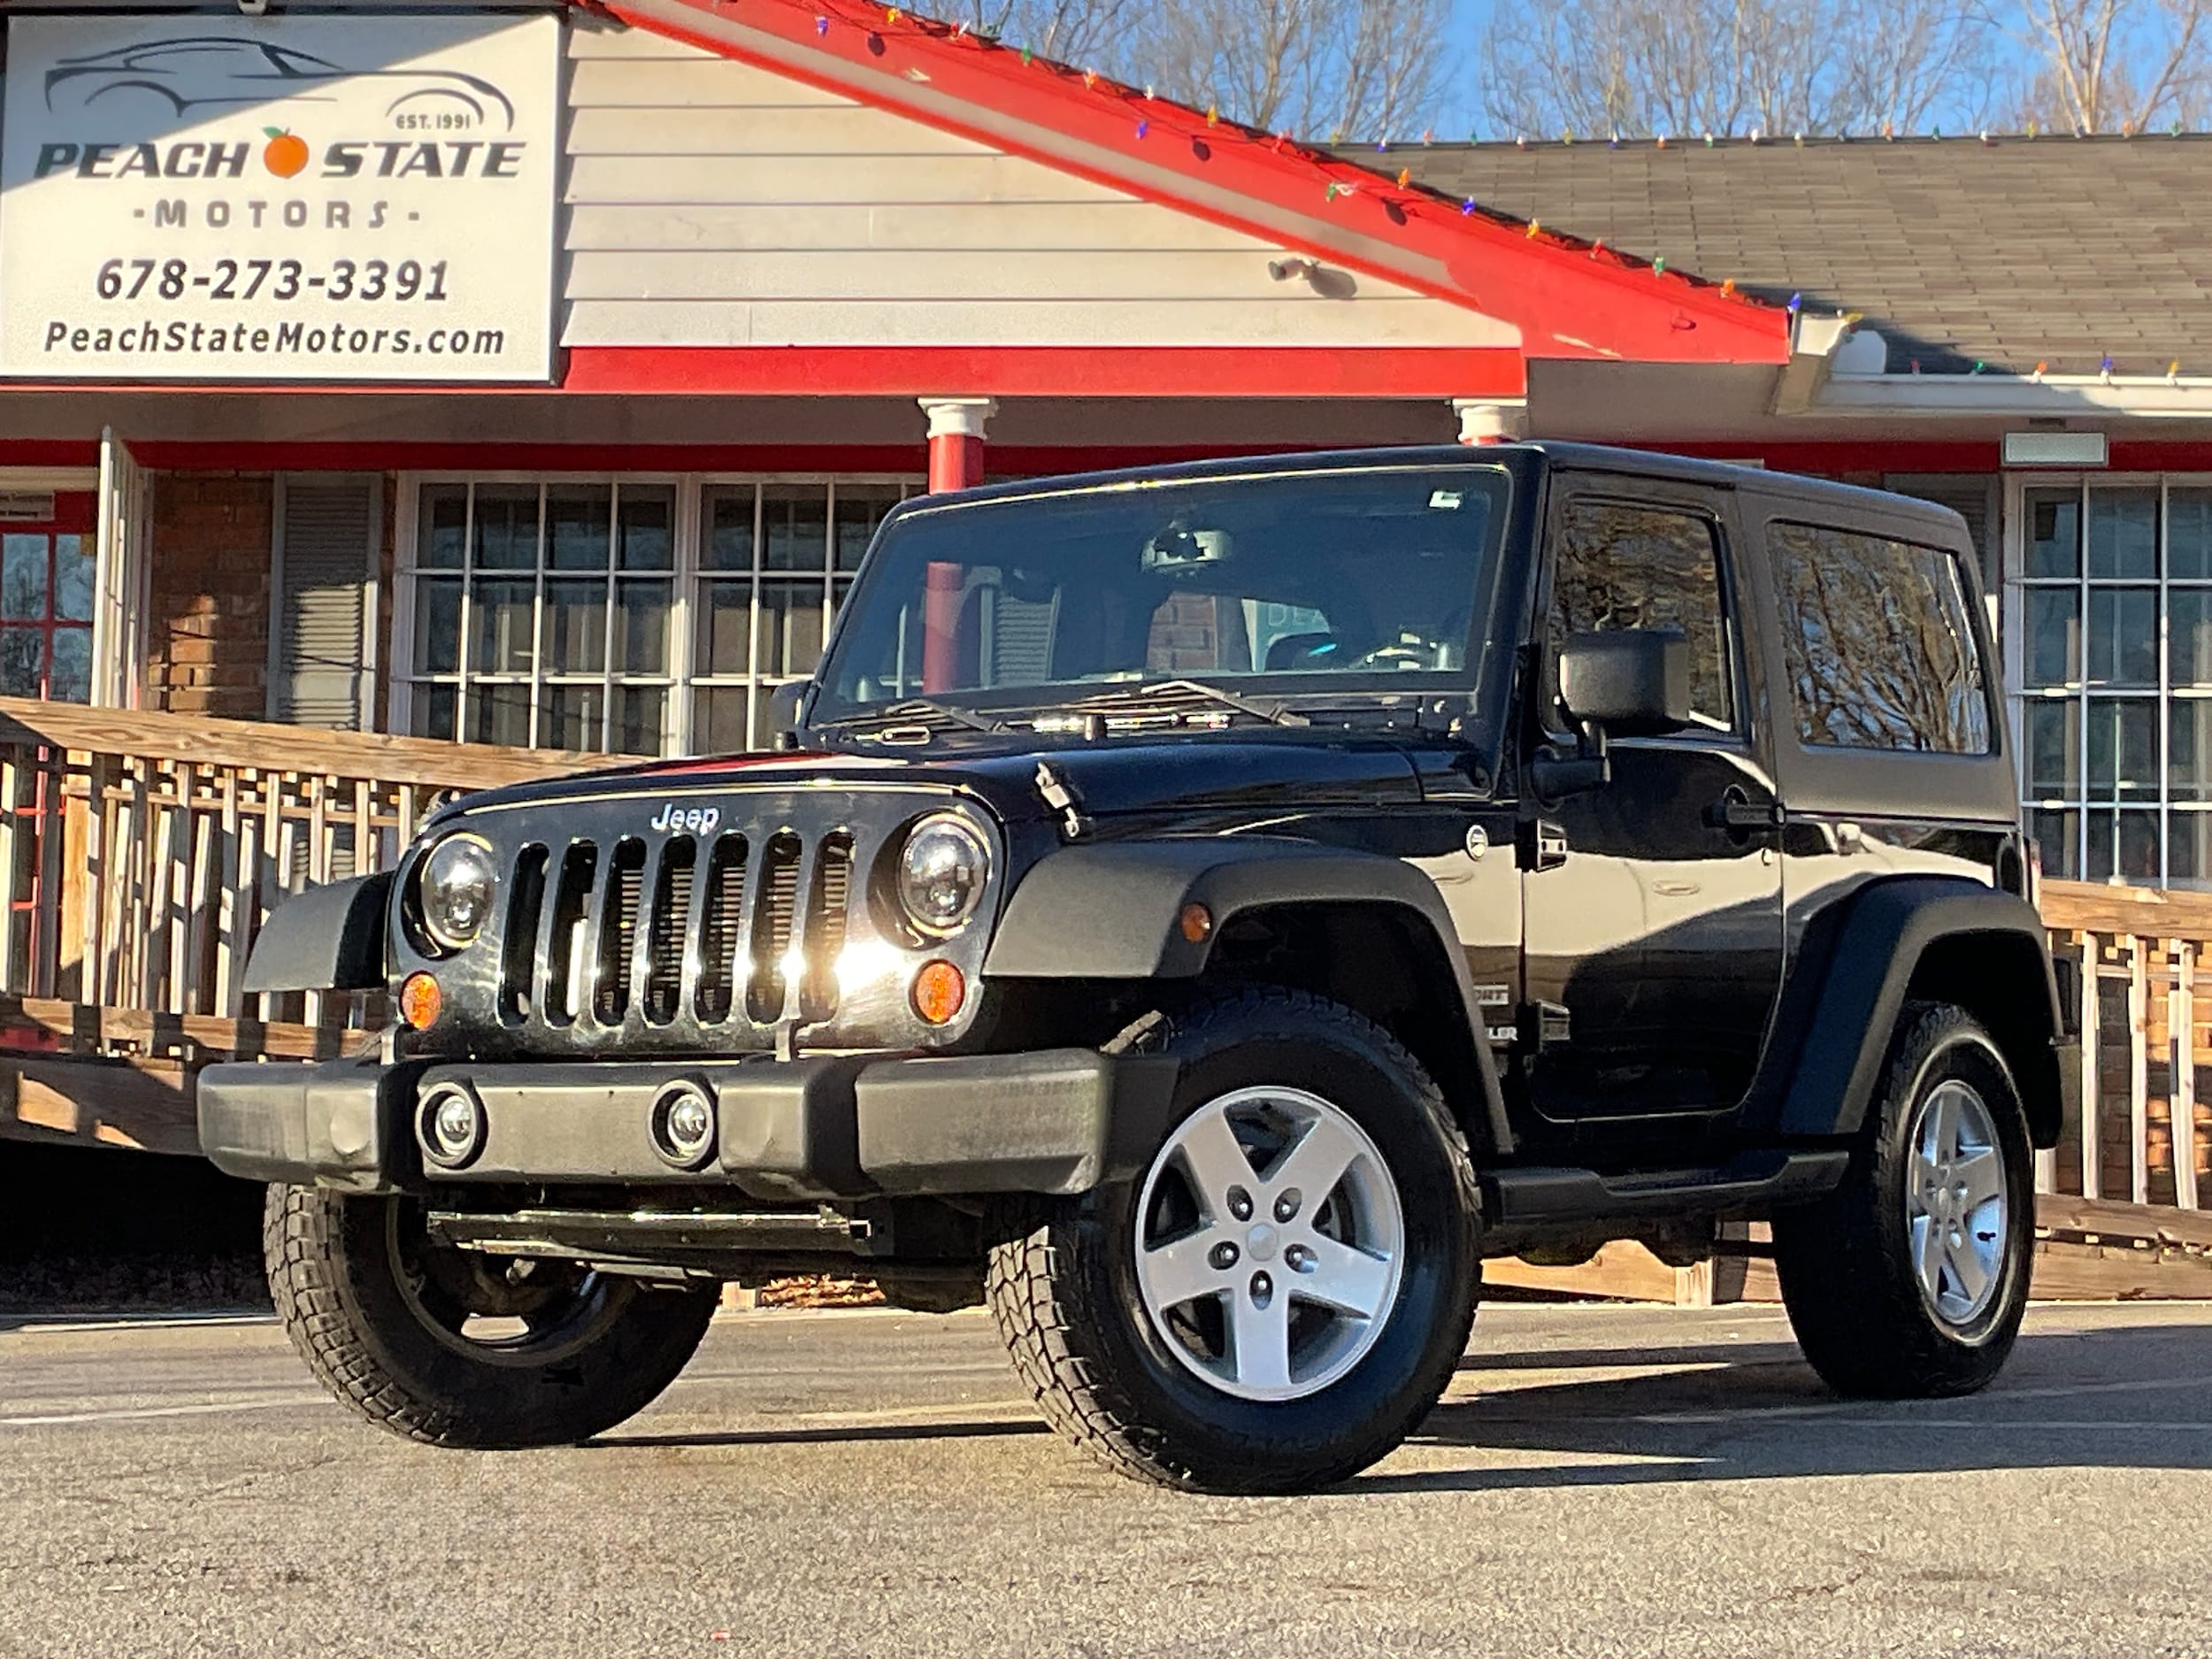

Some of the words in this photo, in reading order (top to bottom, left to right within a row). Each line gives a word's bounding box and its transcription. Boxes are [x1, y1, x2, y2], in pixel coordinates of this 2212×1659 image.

[396, 114, 432, 129] EST.
[437, 114, 470, 129] 1991
[34, 142, 250, 178] PEACH
[320, 142, 526, 177] STATE
[96, 258, 447, 301] 678-273-3391
[44, 321, 503, 354] PeachStateMotors.com
[651, 803, 719, 836] Jeep
